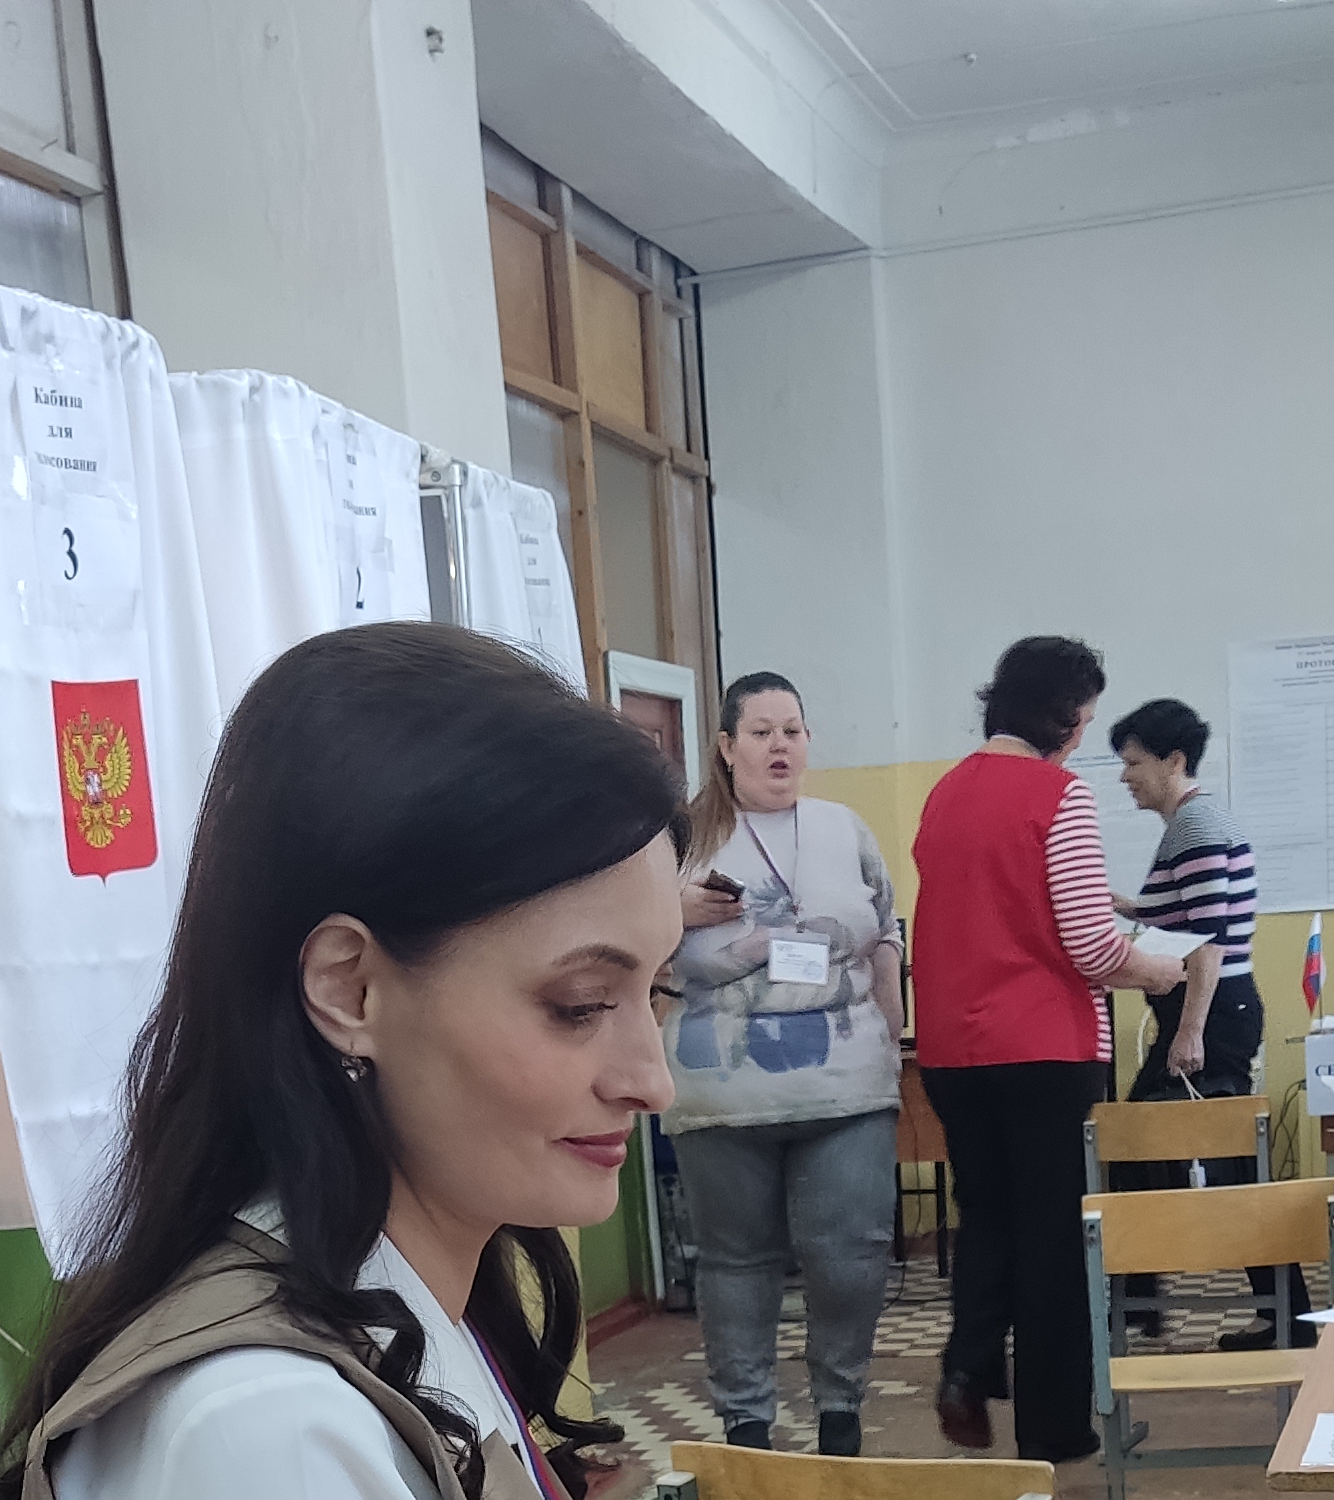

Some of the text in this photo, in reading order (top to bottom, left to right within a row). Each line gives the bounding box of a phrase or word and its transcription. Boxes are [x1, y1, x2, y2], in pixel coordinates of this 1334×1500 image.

[33, 386, 83, 409] Кабина
[47, 425, 73, 439] для
[62, 527, 79, 580] 3
